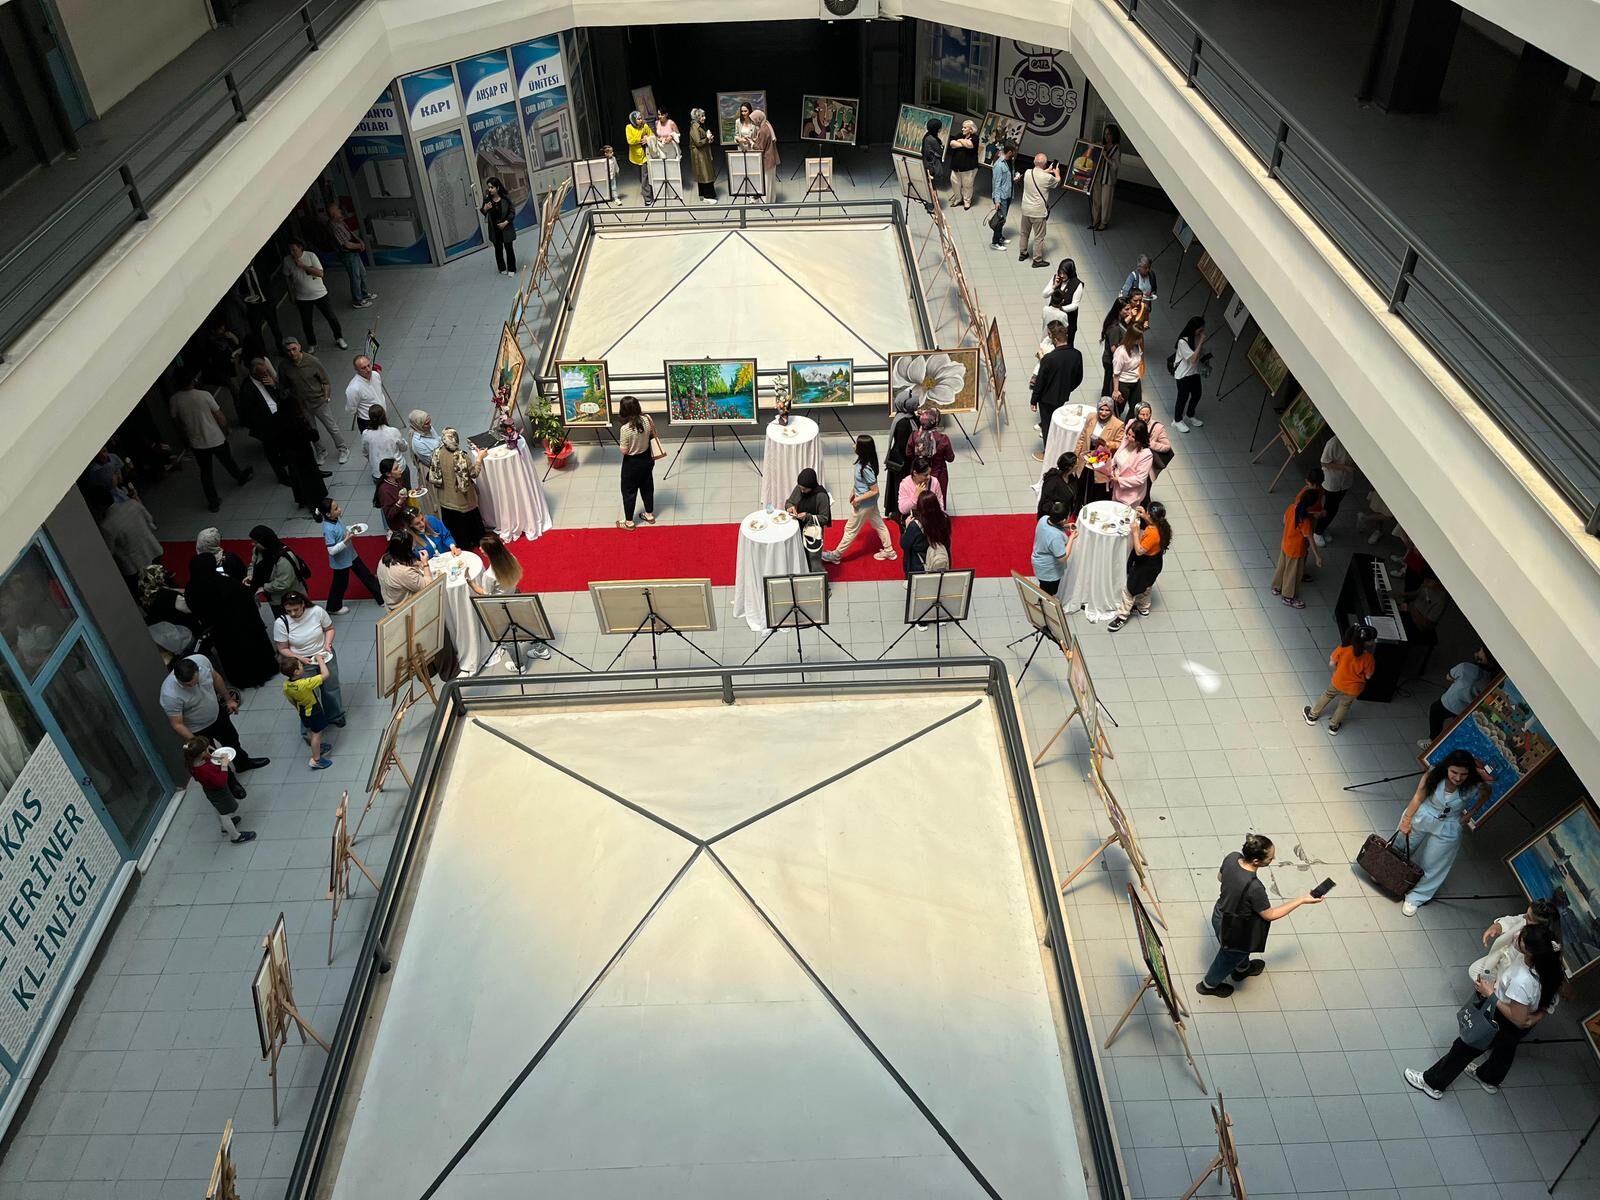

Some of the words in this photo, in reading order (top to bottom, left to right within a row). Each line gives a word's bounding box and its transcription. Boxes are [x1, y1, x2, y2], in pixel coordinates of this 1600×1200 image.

[536, 64, 547, 76] TV
[476, 85, 498, 101] AHŞAP
[500, 82, 508, 94] EV
[1003, 77, 1078, 114] HOŞBEŞ
[364, 108, 394, 118] ANYO
[420, 100, 451, 118] KAPI
[0, 788, 42, 880] KAS
[0, 803, 85, 972] TERİNER
[11, 856, 97, 1012] KLİNİĞİ
